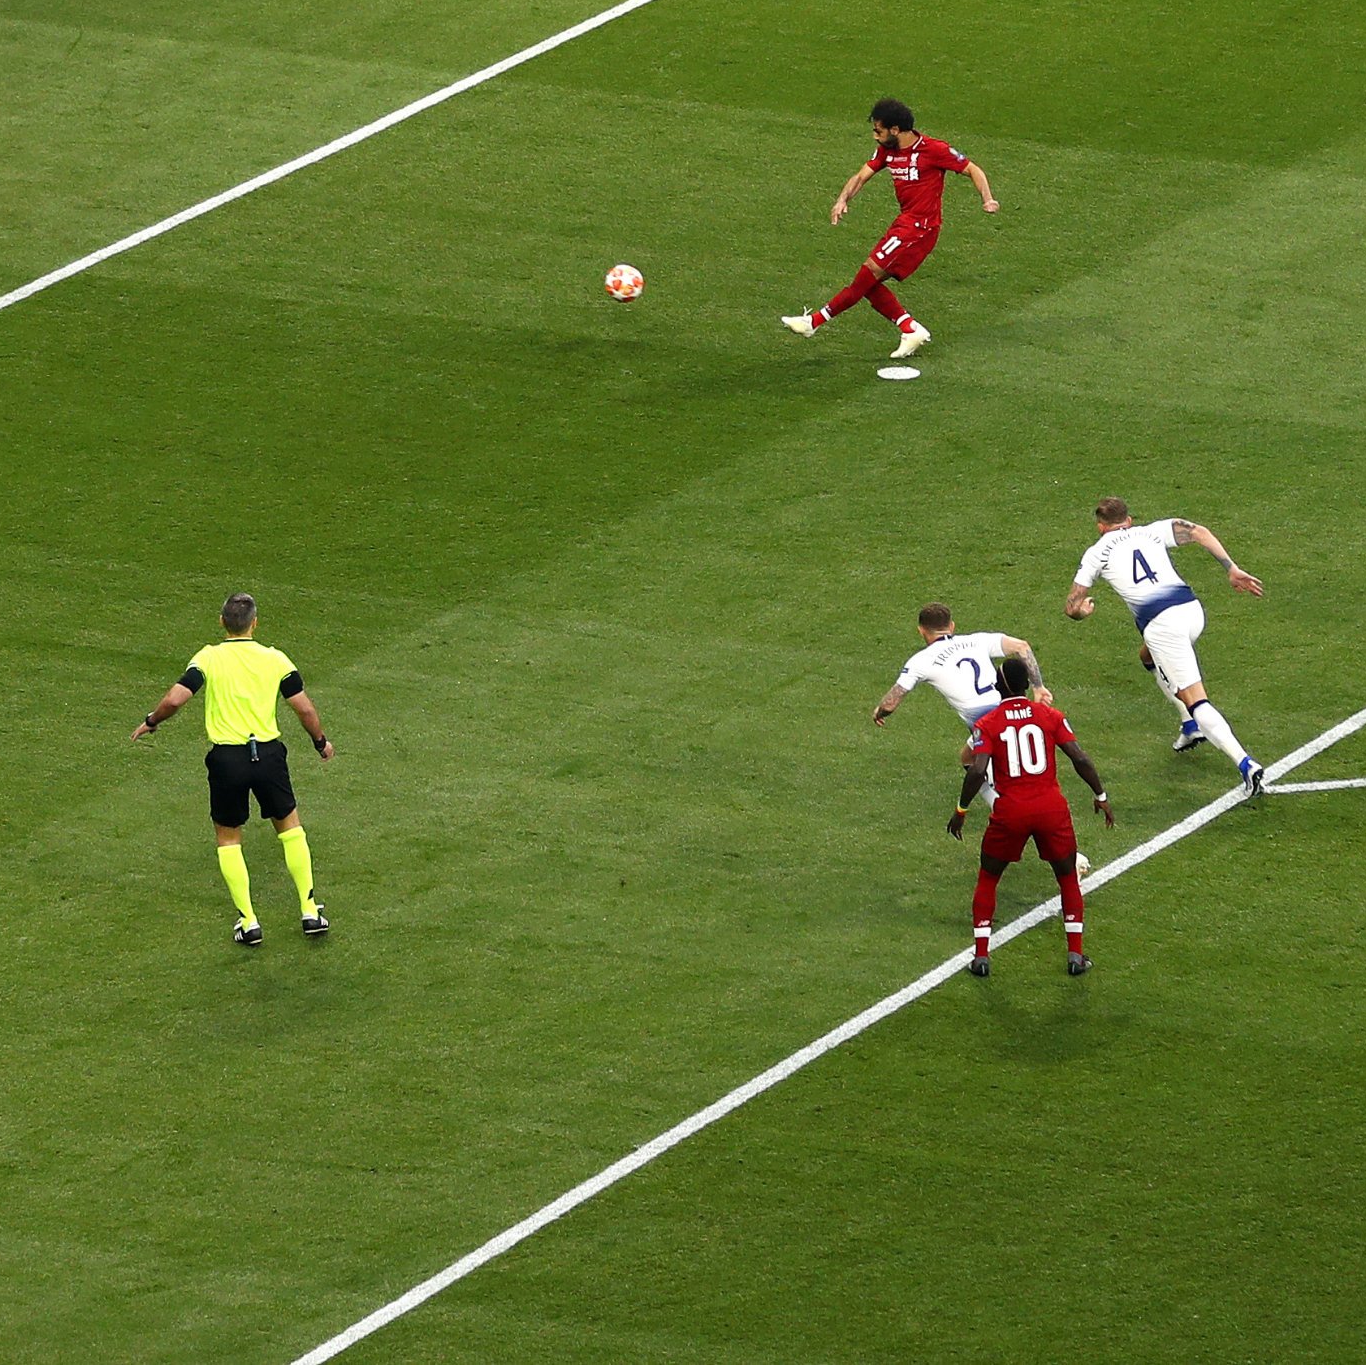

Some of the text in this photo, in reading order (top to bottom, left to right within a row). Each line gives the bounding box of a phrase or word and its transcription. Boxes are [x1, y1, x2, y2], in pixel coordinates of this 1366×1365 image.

[881, 236, 902, 255] 11
[1133, 548, 1159, 585] 4
[955, 656, 995, 696] 2
[1005, 706, 1033, 721] MANÉ
[1000, 723, 1048, 778] 10
